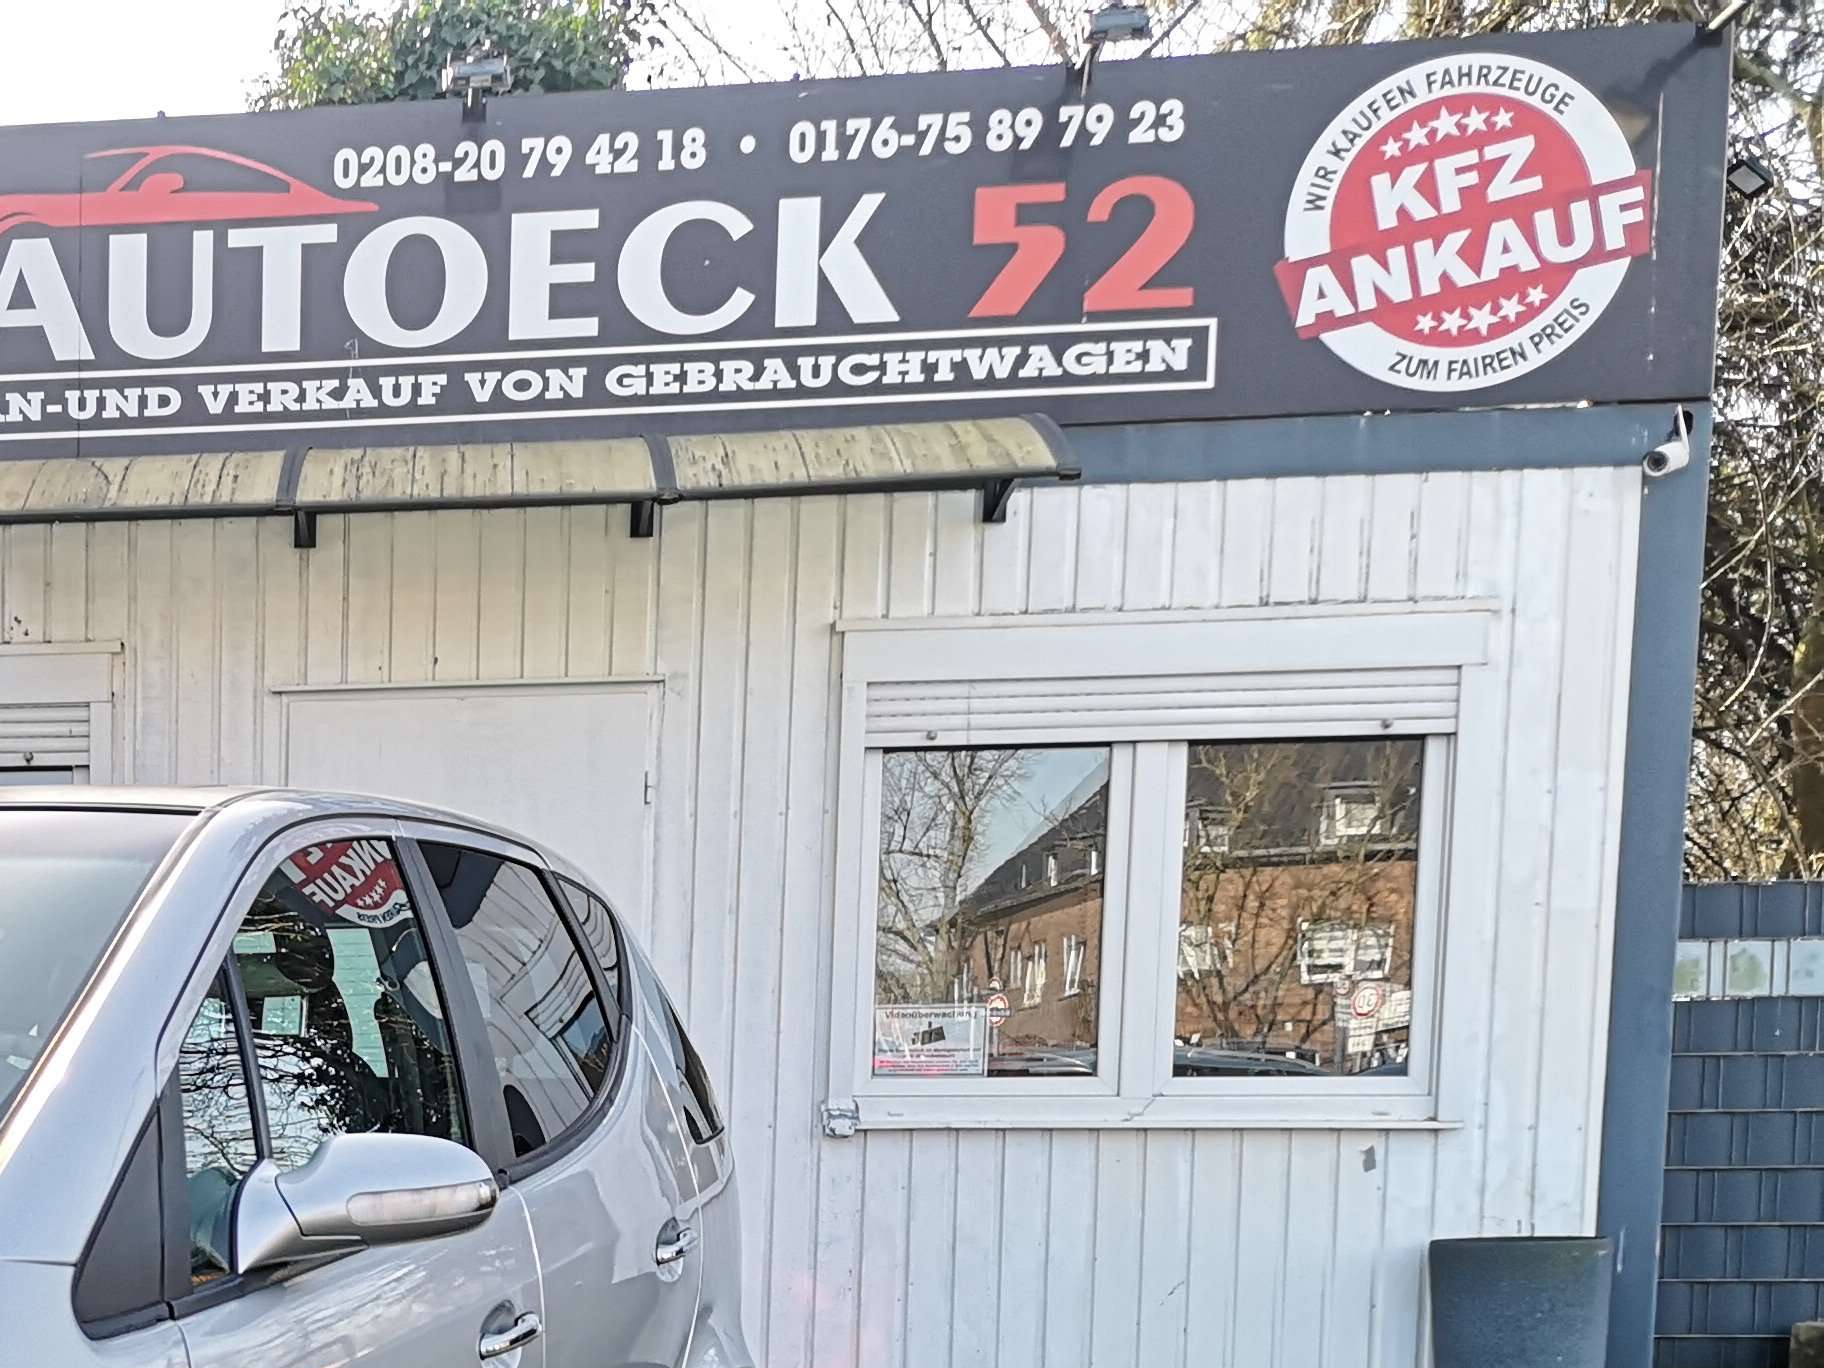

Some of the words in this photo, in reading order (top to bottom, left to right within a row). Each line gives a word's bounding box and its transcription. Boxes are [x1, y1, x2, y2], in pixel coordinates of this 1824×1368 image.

[333, 139, 506, 190] 0208-20
[521, 135, 573, 178] 79
[585, 130, 639, 175] 42
[656, 127, 707, 172] 18
[788, 111, 972, 163] 0176-75
[985, 108, 1041, 152] 89
[1057, 102, 1114, 148] 79
[1128, 98, 1186, 144] 23
[1303, 164, 1338, 212] WIR
[1327, 79, 1418, 162] KAUFEN
[1426, 64, 1575, 116] FAHRZEUGE
[1370, 134, 1543, 231] KFZ
[968, 175, 1196, 318] 52
[1295, 186, 1645, 329] ANKAUF
[197, 374, 448, 416] VERKAUF
[464, 366, 587, 403] VON
[604, 337, 1193, 398] GEBRAUCHTWAGEN
[1387, 351, 1440, 381] ZUM
[1446, 345, 1527, 382] FAIREN
[1530, 297, 1591, 355] PREIS
